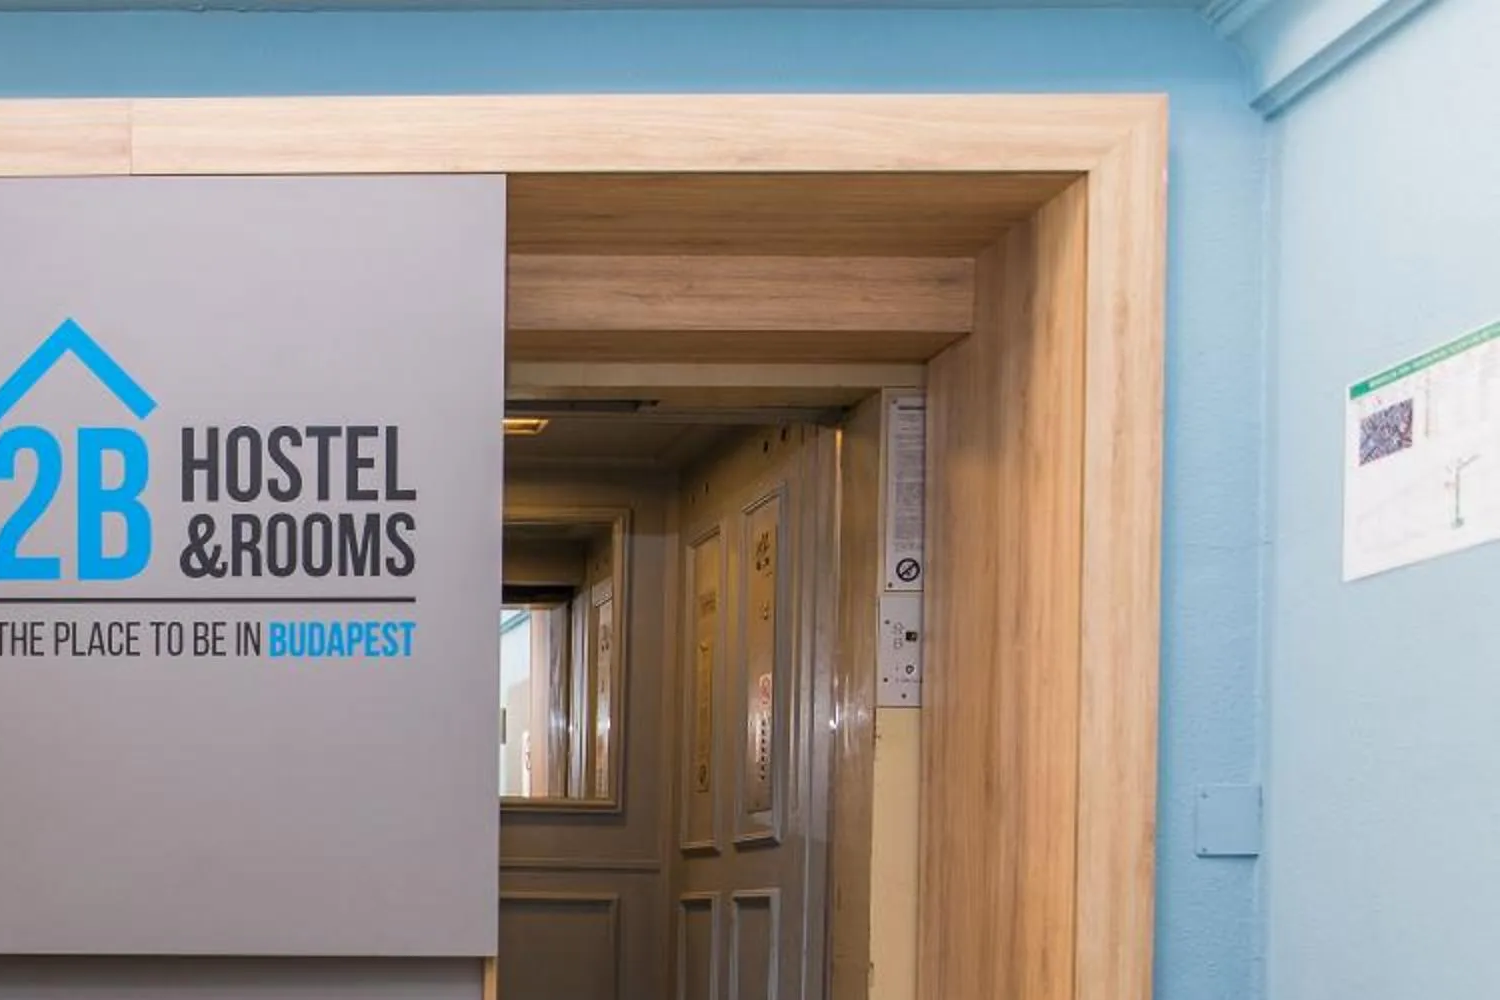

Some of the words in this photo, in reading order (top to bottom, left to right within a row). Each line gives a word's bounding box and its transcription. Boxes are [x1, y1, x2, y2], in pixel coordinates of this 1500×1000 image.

[181, 425, 417, 503] HOSTEL
[180, 512, 417, 579] &ROOMS
[53, 621, 141, 657] PLACE
[149, 621, 185, 657] TO
[192, 621, 228, 657] BE
[235, 621, 262, 657] IN
[268, 620, 417, 658] BUDAPEST
